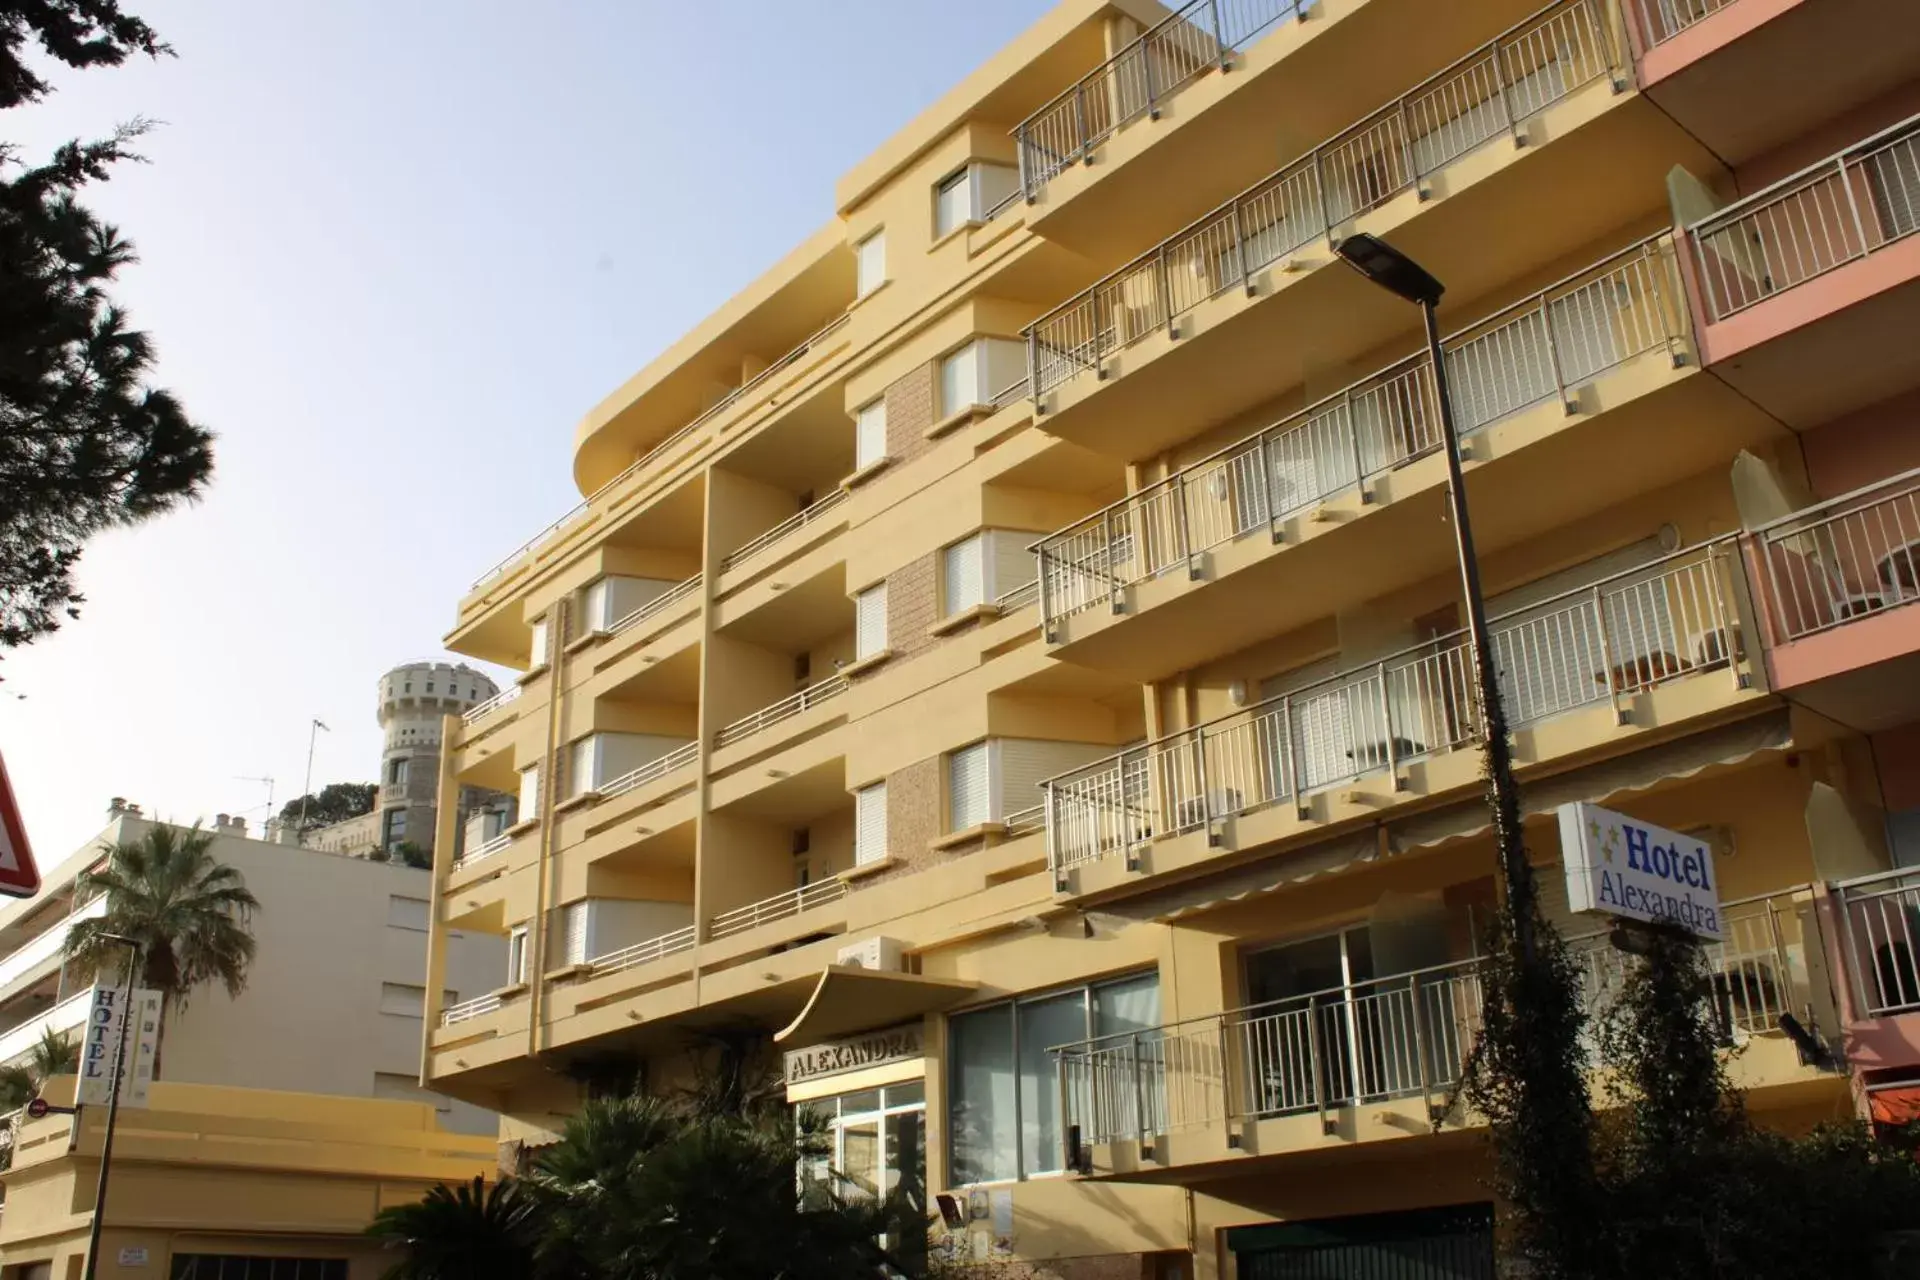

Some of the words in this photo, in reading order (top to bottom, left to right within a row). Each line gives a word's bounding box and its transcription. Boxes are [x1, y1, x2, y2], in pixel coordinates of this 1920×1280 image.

[1622, 824, 1711, 891] Hotel
[1599, 869, 1720, 933] Alexandra
[86, 990, 116, 1078] HOTEL
[791, 1030, 920, 1081] ALEXANDRA
